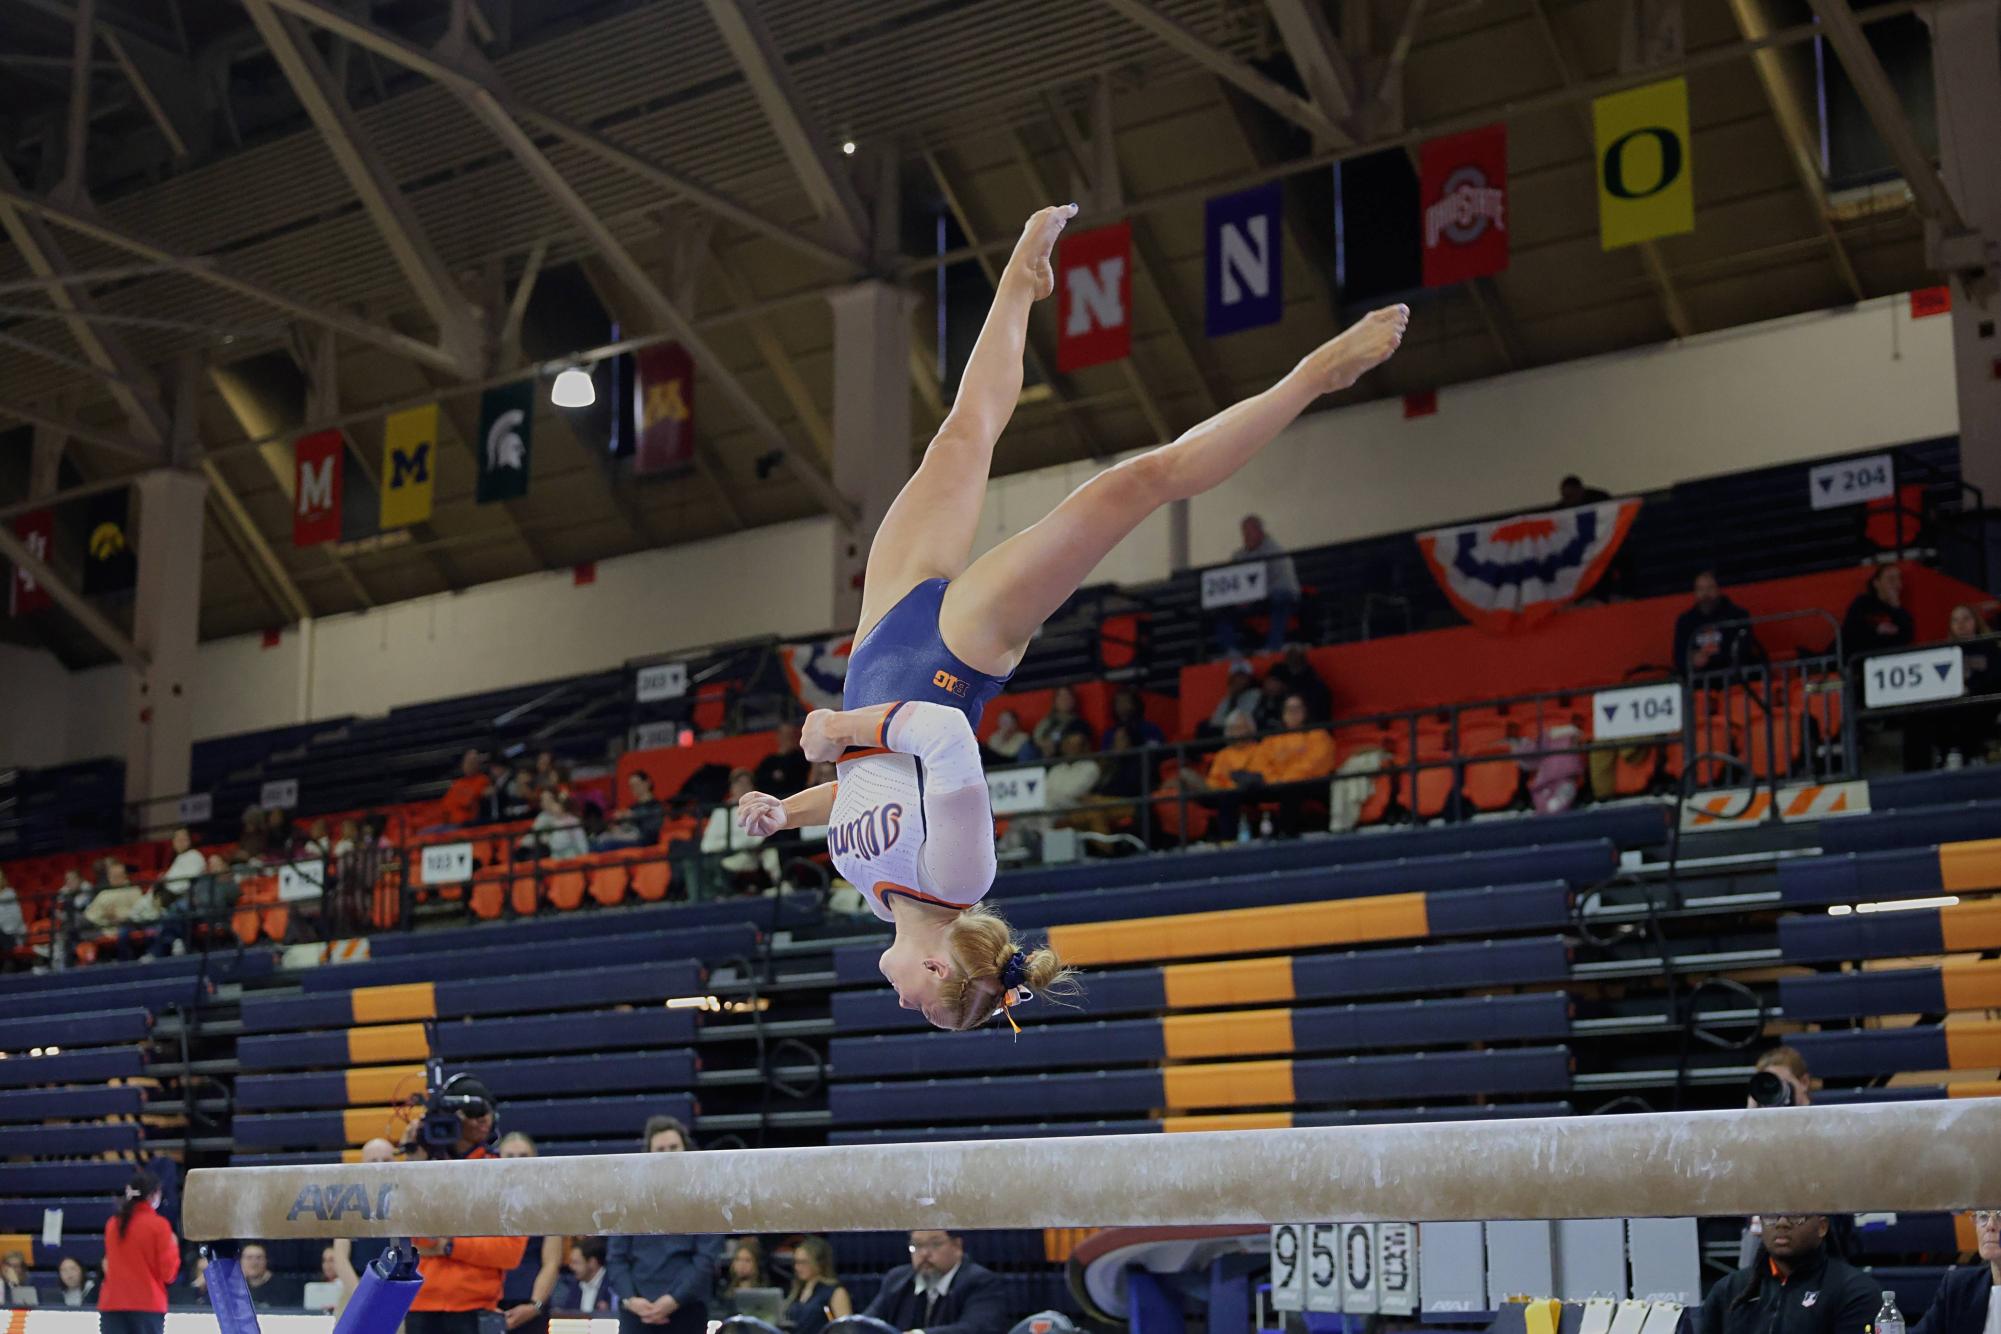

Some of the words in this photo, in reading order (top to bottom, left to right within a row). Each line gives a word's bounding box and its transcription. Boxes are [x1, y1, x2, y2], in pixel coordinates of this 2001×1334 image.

[1604, 126, 1681, 199] O
[1221, 214, 1268, 305] N
[1066, 256, 1124, 337] N
[300, 455, 335, 515] M
[391, 441, 430, 489] M
[1842, 464, 1886, 492] 204
[1874, 664, 1922, 690] 105
[1630, 696, 1674, 721] 104
